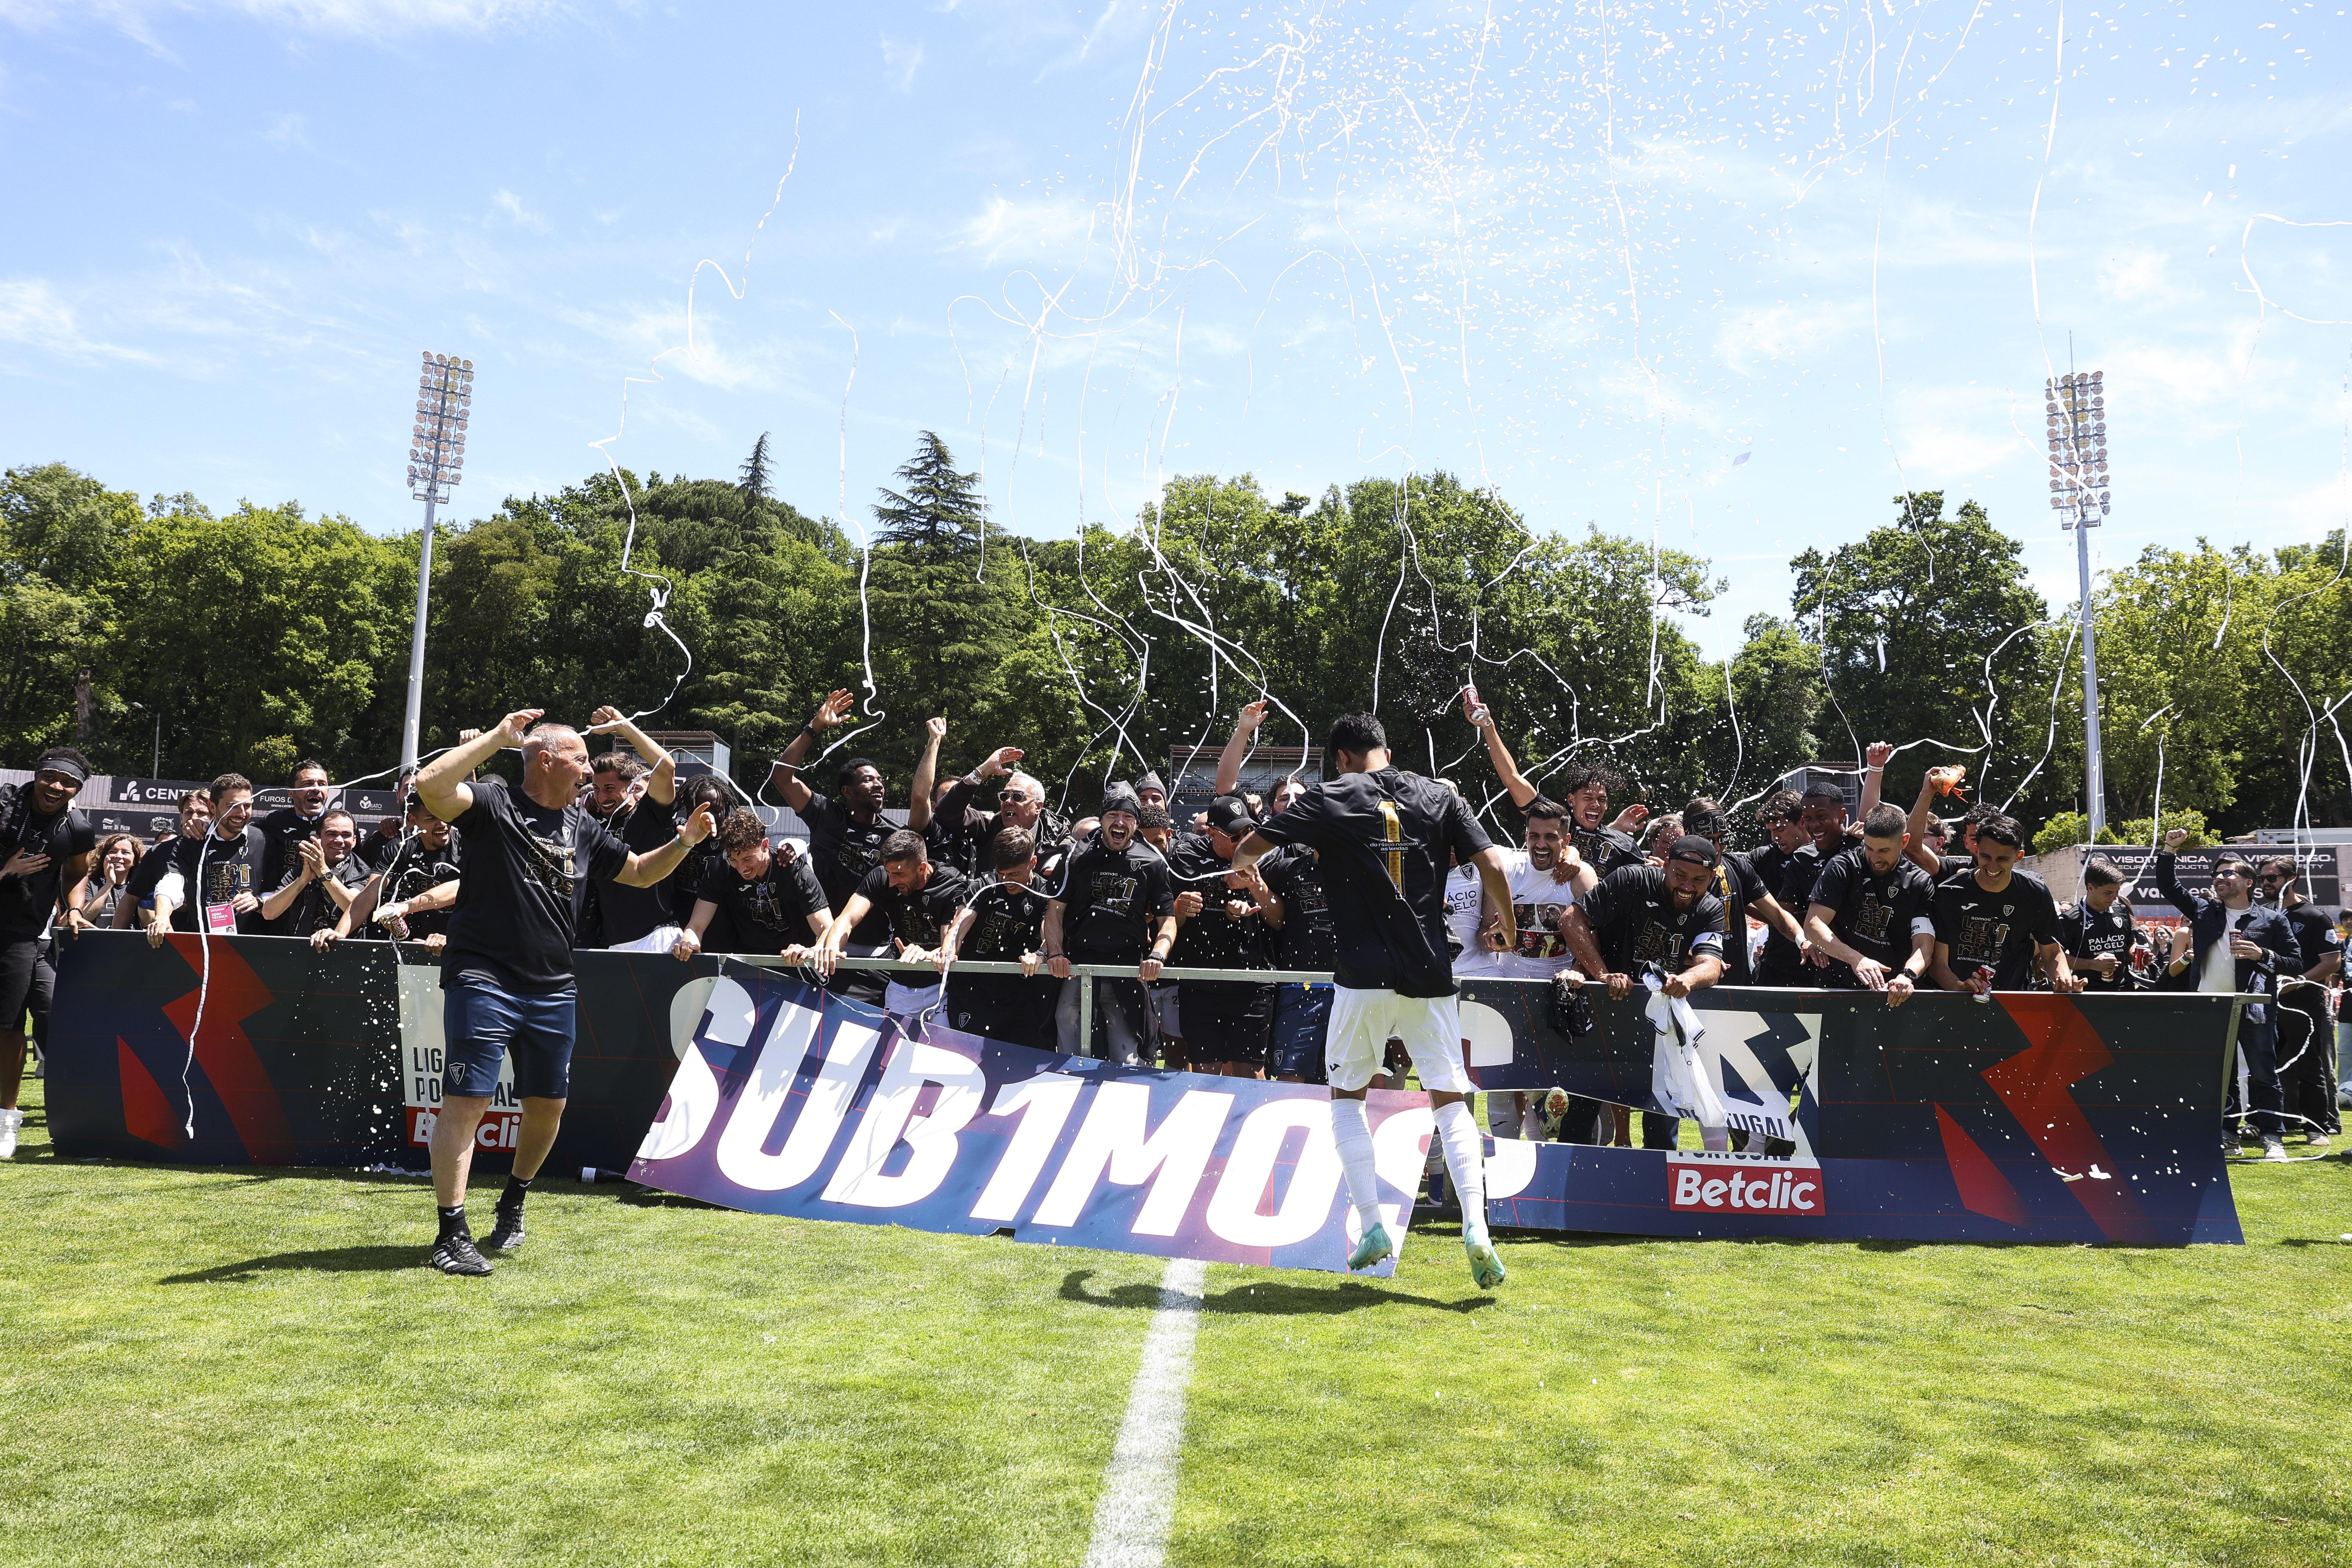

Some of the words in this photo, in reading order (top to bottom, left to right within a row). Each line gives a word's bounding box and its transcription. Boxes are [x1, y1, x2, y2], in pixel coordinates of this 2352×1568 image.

[1447, 890, 1476, 903] ÁCIO
[1454, 900, 1477, 911] ELO
[995, 911, 1013, 919] somos
[2088, 934, 2125, 945] PALÁCIO
[413, 1047, 443, 1073] LIG
[415, 1077, 519, 1107] POAL
[413, 1112, 520, 1148] Bcli
[1675, 1169, 1817, 1210] Betclic
